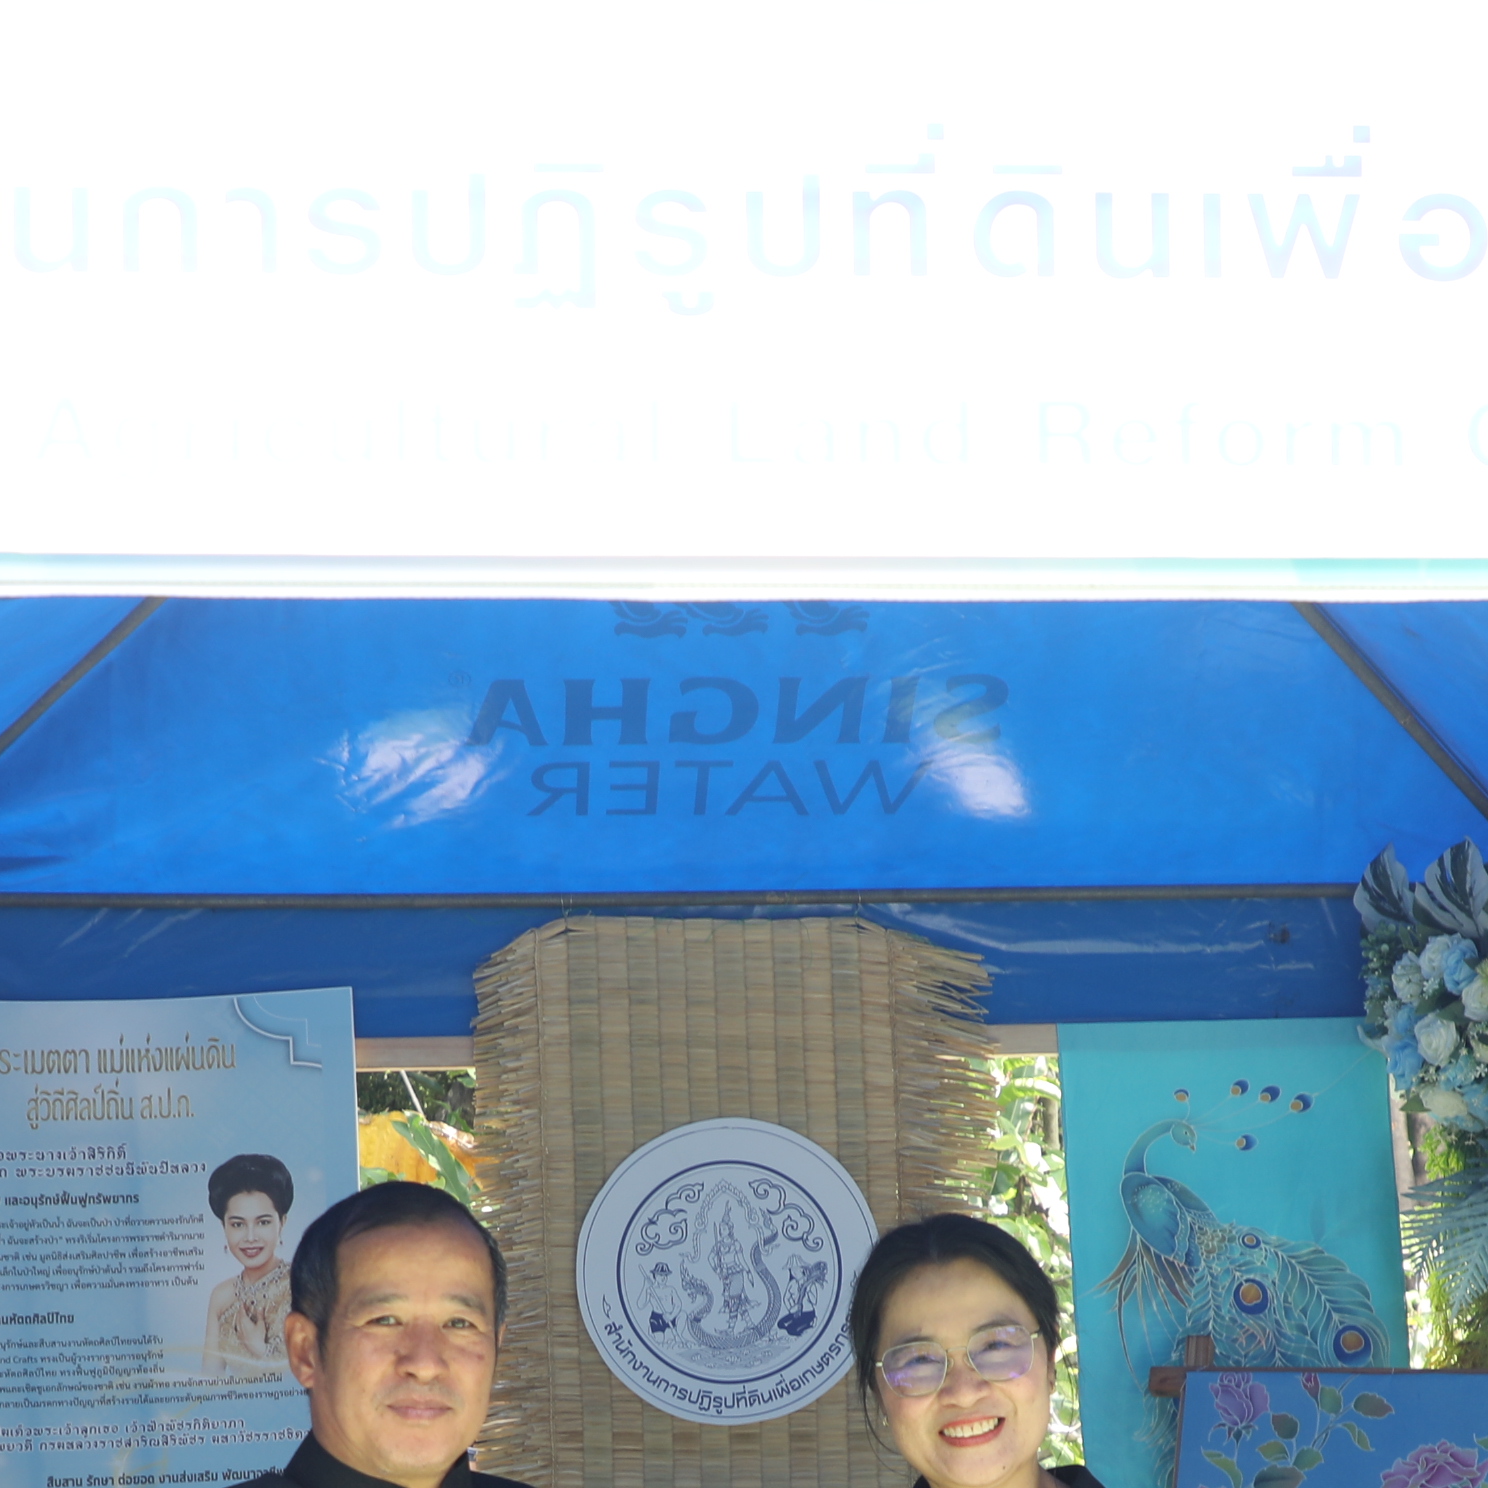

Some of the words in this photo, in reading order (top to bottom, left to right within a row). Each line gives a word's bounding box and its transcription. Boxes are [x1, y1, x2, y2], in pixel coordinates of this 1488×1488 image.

[724, 399, 974, 477] Land
[1034, 399, 1410, 477] Reform
[97, 1032, 236, 1075] แม่แห่งแผ่นดิน
[25, 1078, 134, 1130] สู่วิถีศิลป์ถิ่น
[141, 1088, 195, 1122] ส.ป.ก.
[5, 1190, 139, 1209] และอนุรักษ์ฟื้นฟูทรัพยากร
[13, 1356, 37, 1364] Crafts
[604, 1305, 854, 1415] สำนักงานการปฏิรูปที่ดินเพื่อเกษตรกร
[47, 1473, 82, 1488] สืบสาน
[87, 1471, 113, 1488] รักษา
[118, 1471, 154, 1486] ต่อยอด
[159, 1468, 218, 1486] งานส่งเสริม
